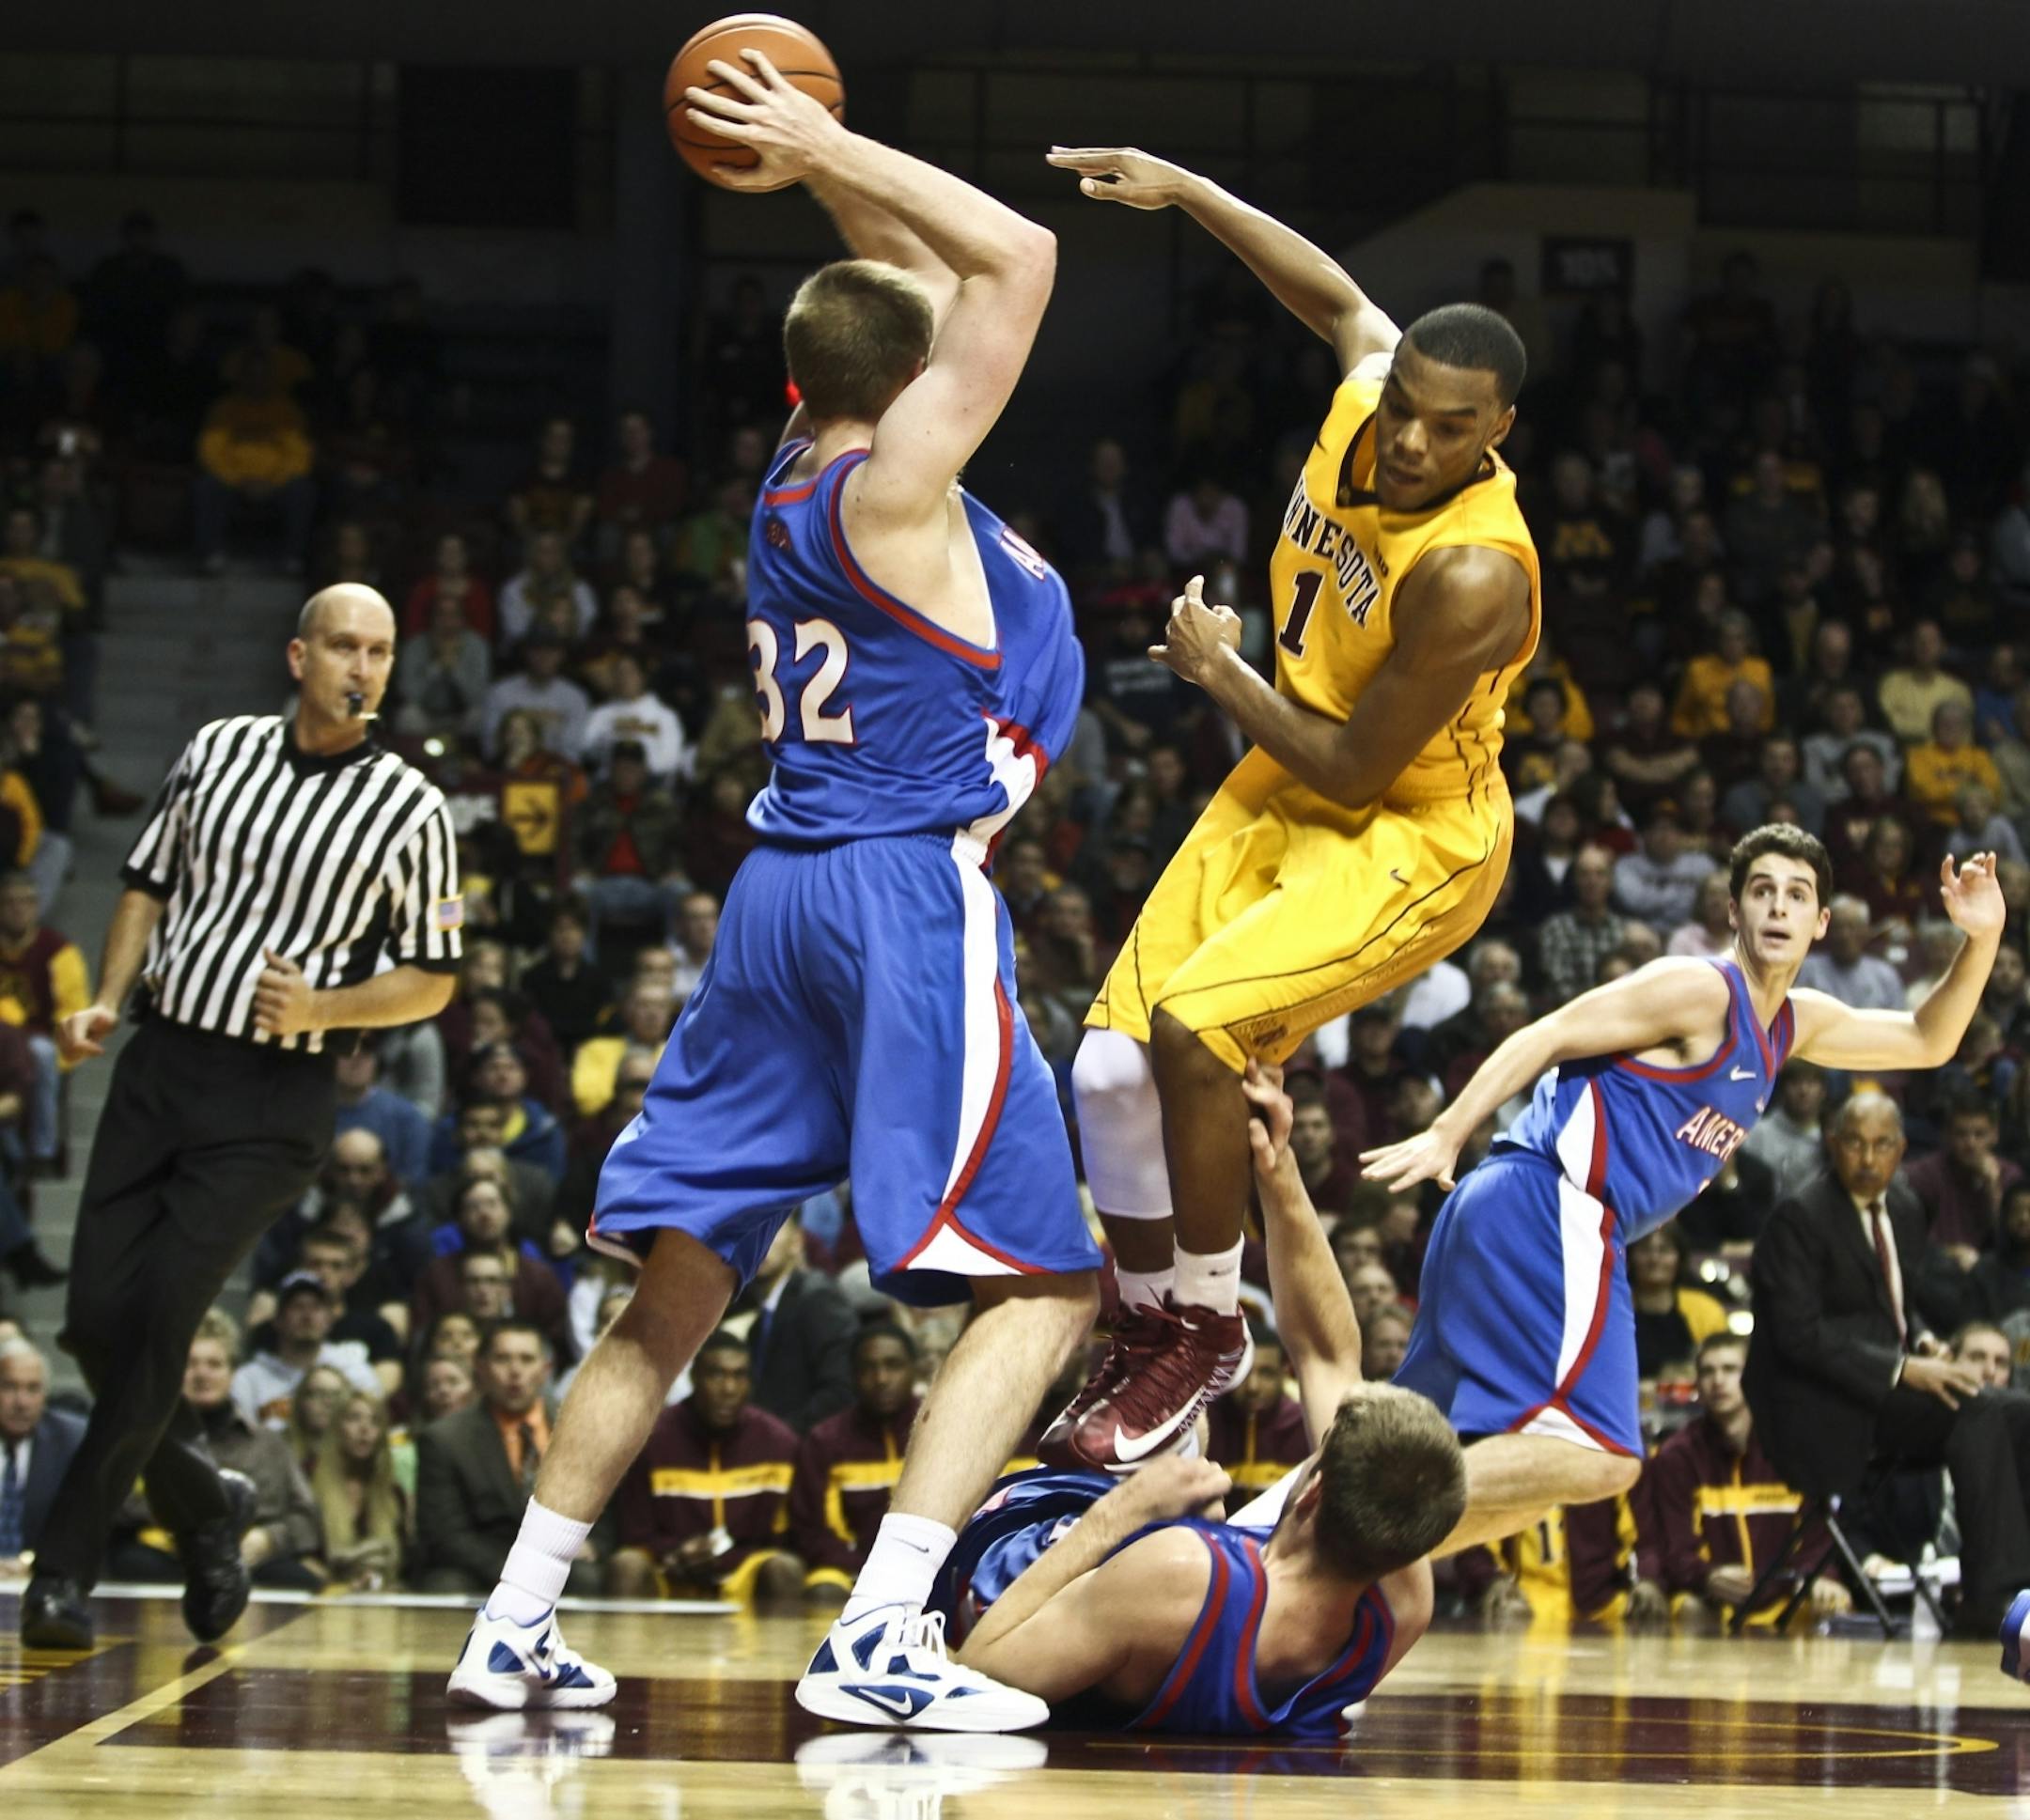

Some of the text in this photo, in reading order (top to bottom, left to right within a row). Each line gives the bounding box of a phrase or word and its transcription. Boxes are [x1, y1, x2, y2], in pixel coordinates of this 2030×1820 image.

[1277, 568, 1326, 660] 1
[746, 617, 856, 745] 32
[1675, 1105, 1748, 1162] AMER
